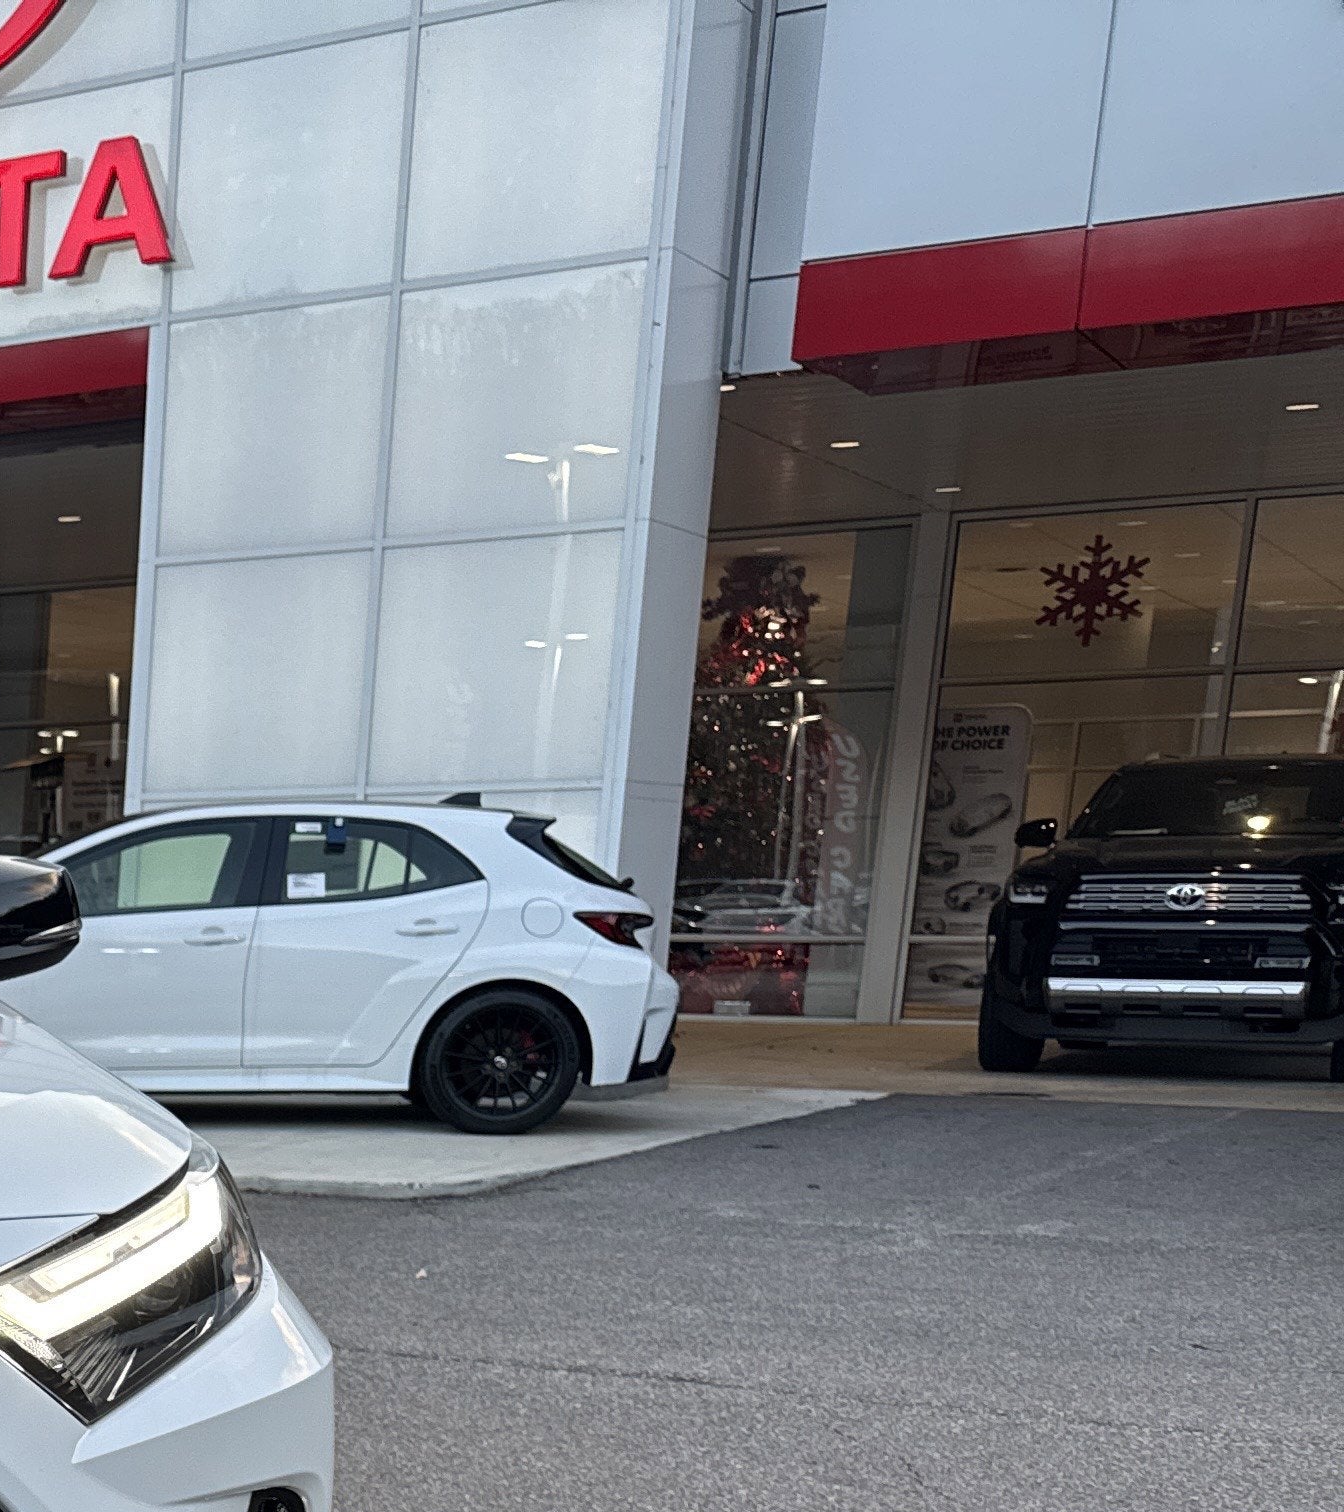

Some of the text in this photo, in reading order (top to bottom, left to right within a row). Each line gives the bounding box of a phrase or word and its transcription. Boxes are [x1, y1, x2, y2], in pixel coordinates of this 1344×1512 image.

[936, 724, 1011, 738] HE POWER
[952, 738, 1005, 751] CHOICE
